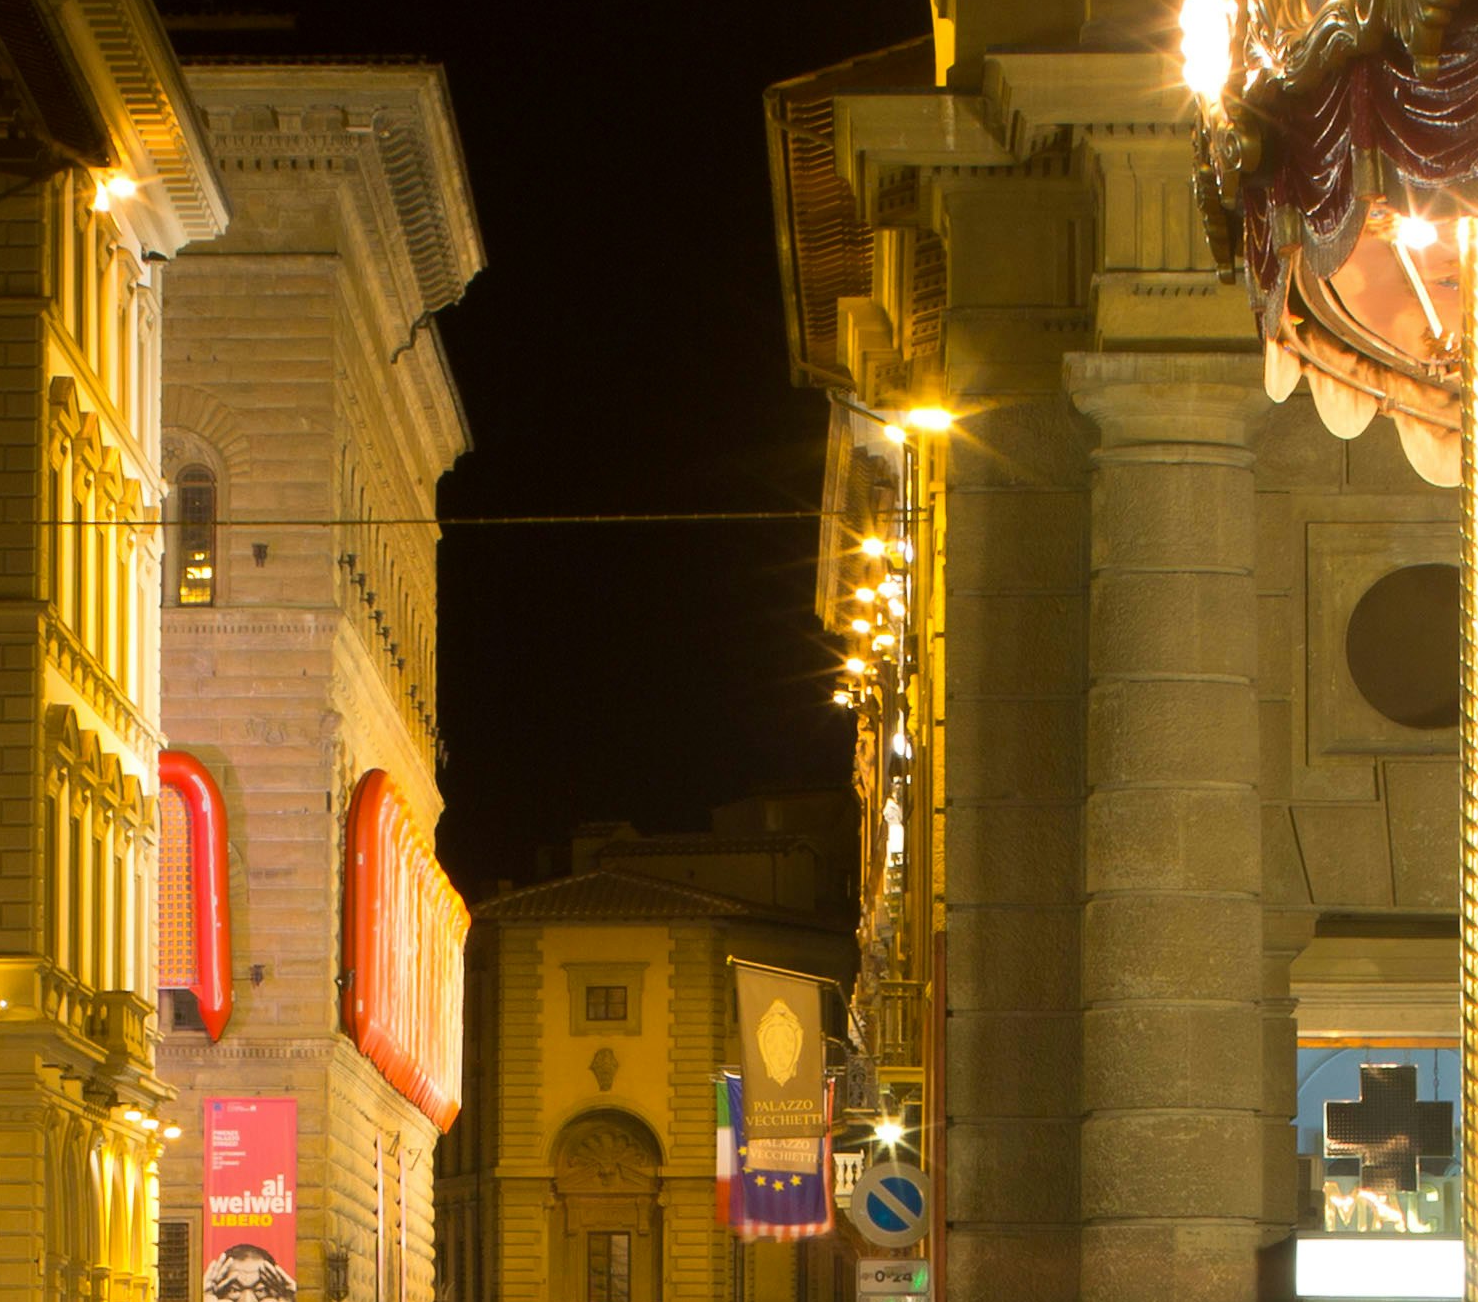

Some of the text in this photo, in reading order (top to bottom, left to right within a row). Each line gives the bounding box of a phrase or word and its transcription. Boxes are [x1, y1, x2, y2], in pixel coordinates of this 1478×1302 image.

[753, 1099, 814, 1112] PALAZZO
[745, 1113, 823, 1127] VECCHIETTI
[261, 1174, 285, 1197] ai
[208, 1190, 293, 1214] weiwei
[211, 1214, 273, 1227] LIBERO
